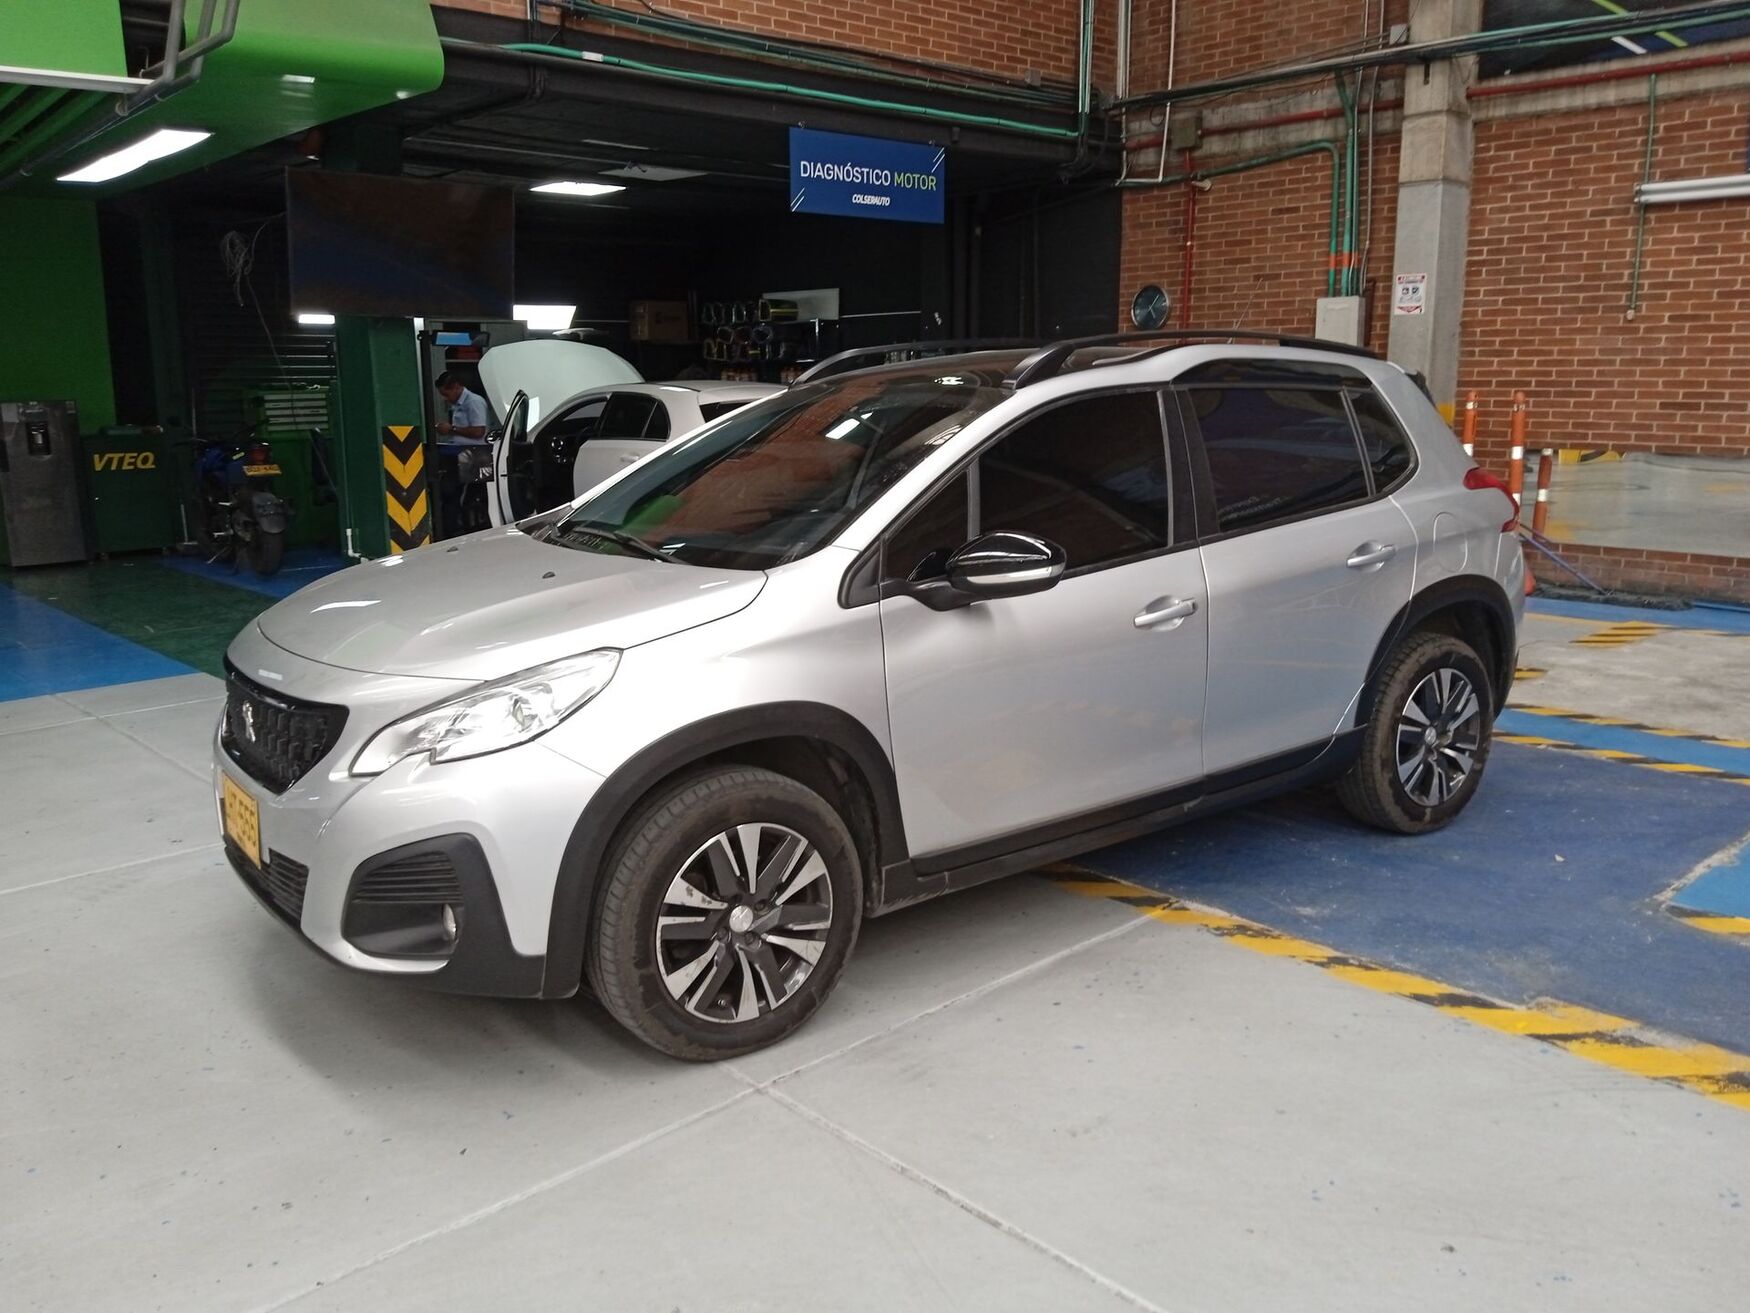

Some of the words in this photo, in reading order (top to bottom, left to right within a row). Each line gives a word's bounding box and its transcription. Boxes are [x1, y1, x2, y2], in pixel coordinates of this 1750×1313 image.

[800, 160, 891, 186] DIAGNÓSTICO
[894, 172, 937, 191] MOTOR
[851, 194, 891, 207] COLSERAUTO
[93, 452, 156, 471] VTEQ
